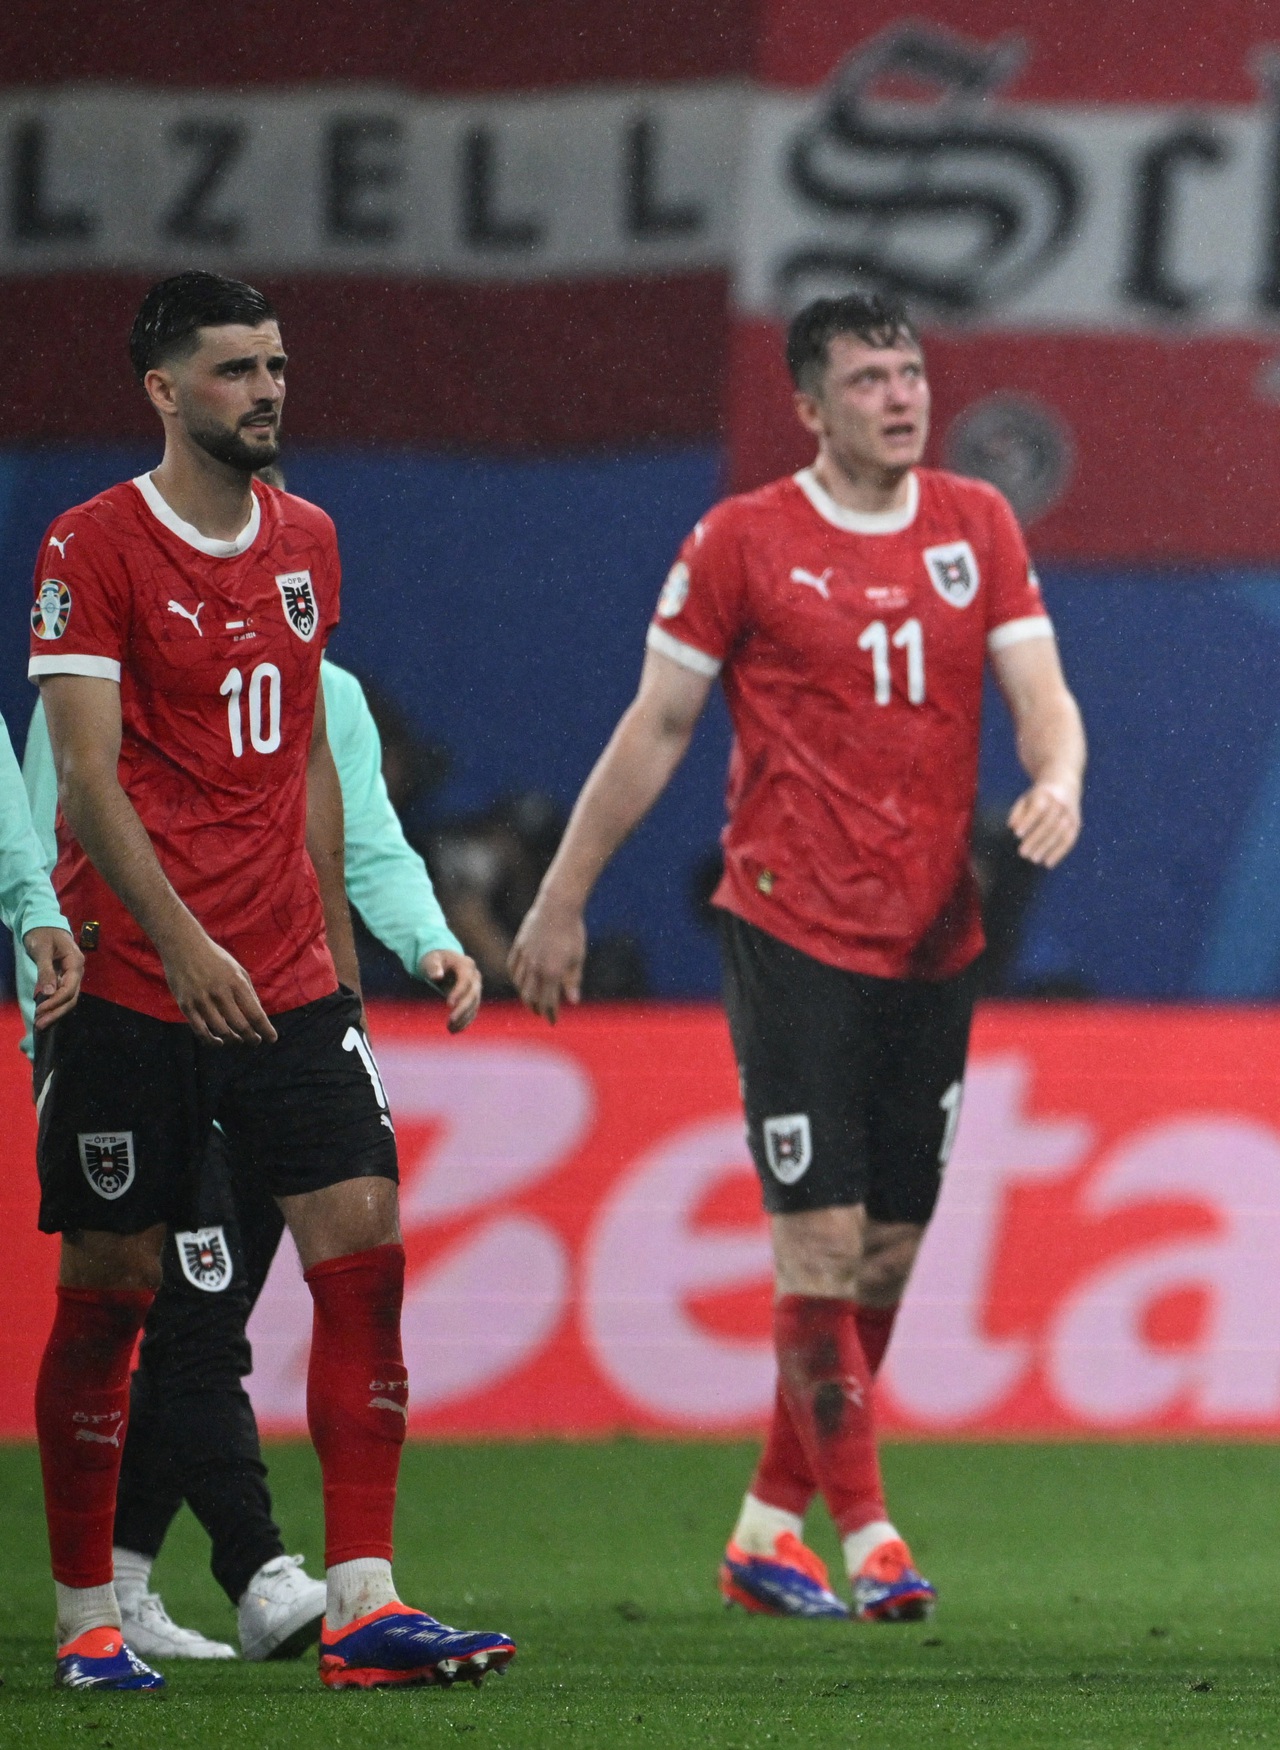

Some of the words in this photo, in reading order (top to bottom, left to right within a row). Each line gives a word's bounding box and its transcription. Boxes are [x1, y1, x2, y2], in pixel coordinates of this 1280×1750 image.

[8, 110, 705, 252] LZELL
[858, 617, 926, 706] 11
[219, 662, 282, 758] 10
[341, 1025, 389, 1110] 1
